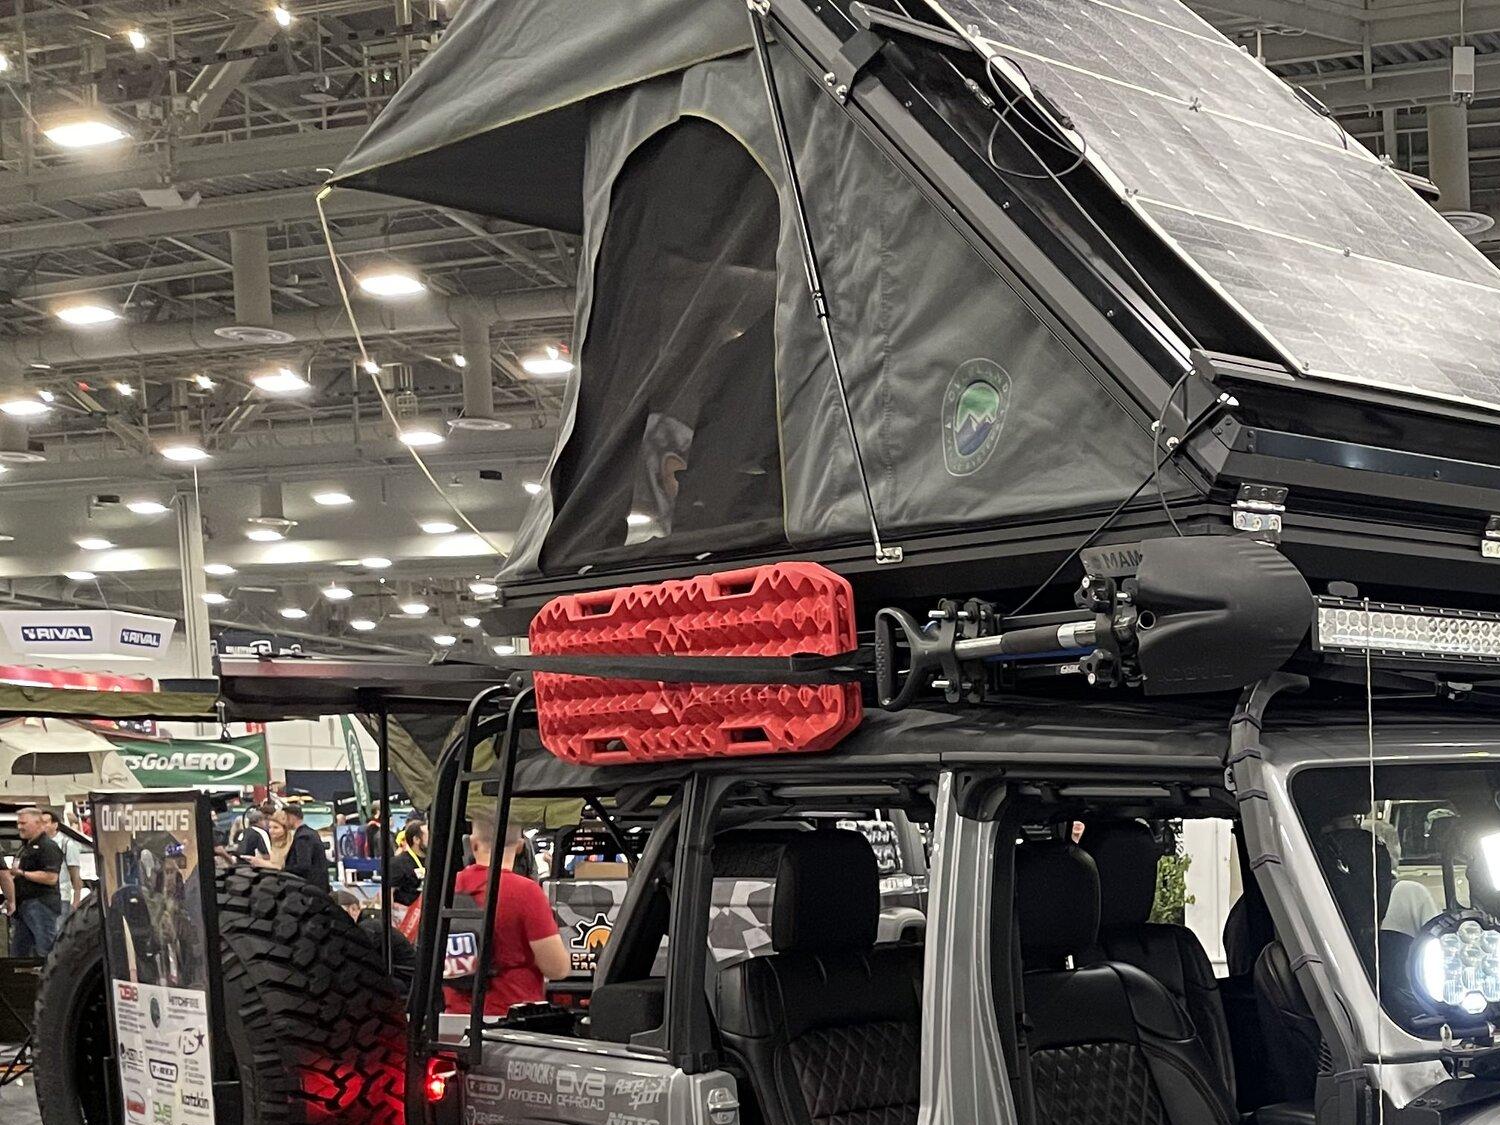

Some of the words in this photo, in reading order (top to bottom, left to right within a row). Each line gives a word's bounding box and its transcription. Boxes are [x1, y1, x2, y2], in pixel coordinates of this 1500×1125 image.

[35, 626, 91, 641] RIVAL
[129, 630, 160, 646] RIVAL
[101, 804, 122, 831] Our
[123, 804, 190, 839] Sponsors
[508, 1088, 553, 1105] RYDEEN
